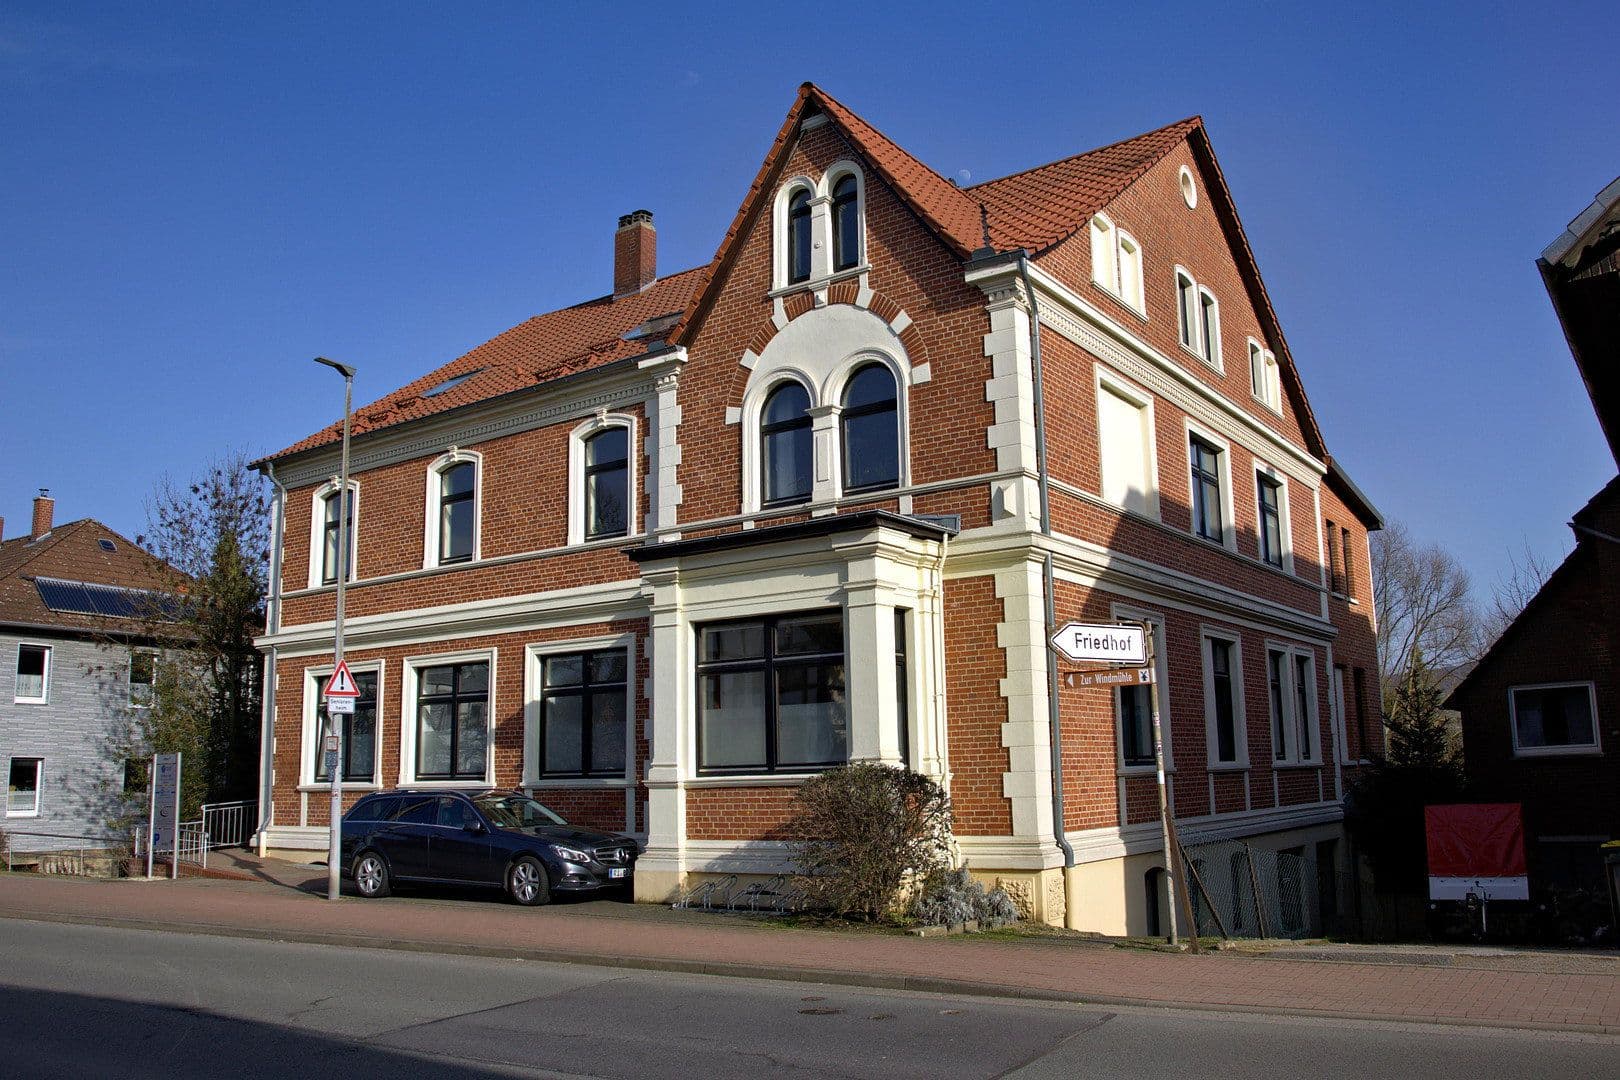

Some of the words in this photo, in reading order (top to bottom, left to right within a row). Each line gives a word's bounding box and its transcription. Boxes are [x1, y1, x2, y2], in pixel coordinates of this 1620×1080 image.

[1074, 632, 1131, 651] Friedhof
[1080, 674, 1092, 685] Zur
[1095, 672, 1132, 684] Windmühle
